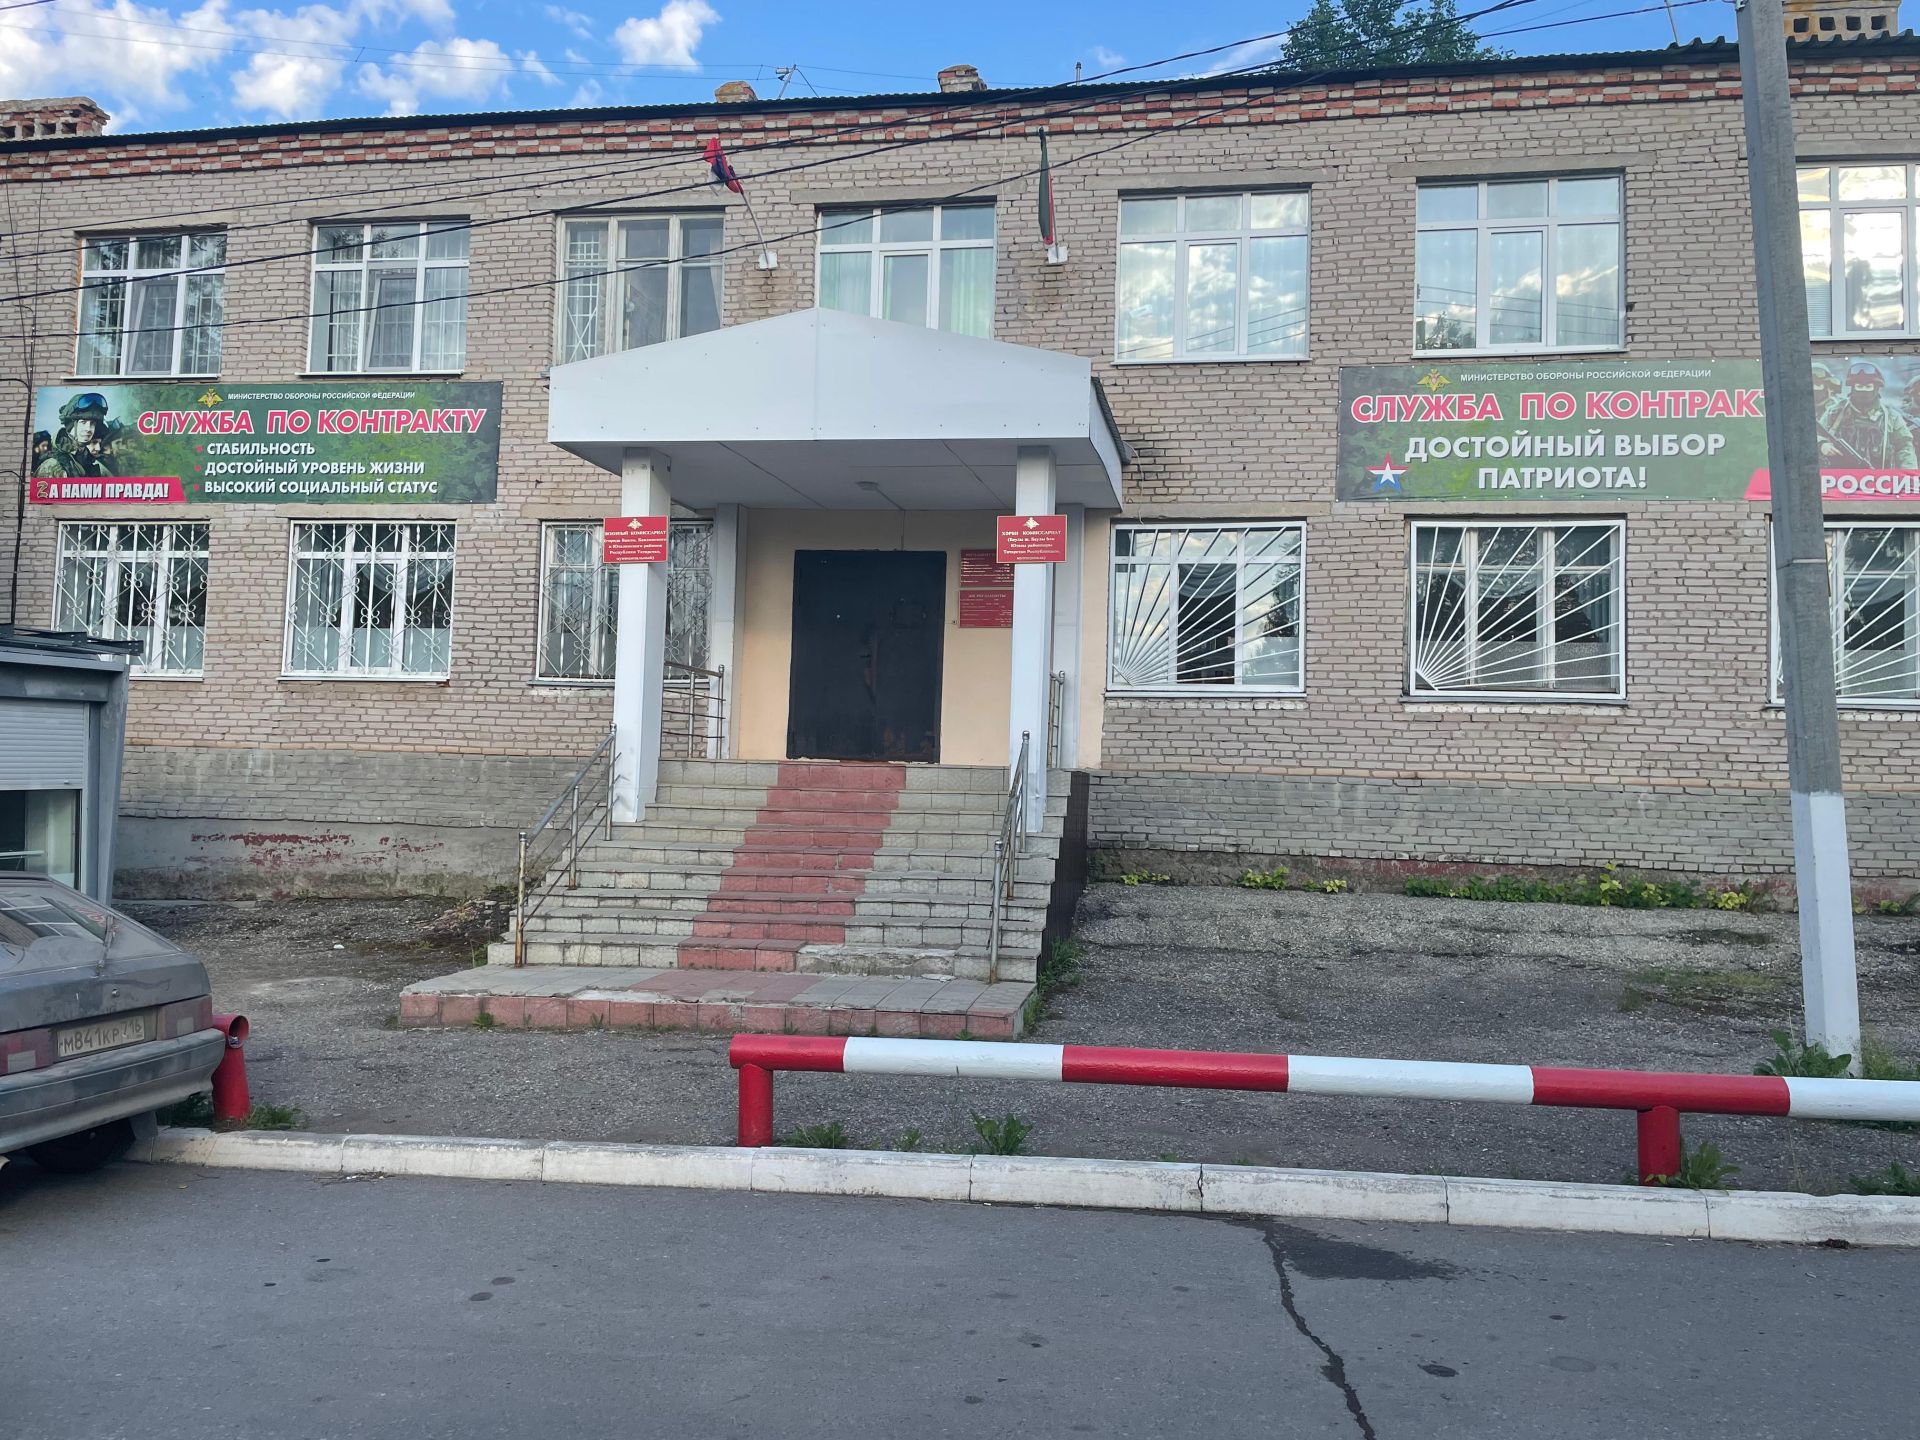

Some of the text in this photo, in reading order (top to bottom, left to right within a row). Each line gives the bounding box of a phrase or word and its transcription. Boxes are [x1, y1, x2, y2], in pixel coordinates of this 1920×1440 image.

[1460, 370, 1712, 382] МИНИСТЕРСТВО ОБОРОНЫ РОССИЙСКОЙ ФЕДЕРАЦИИ
[322, 390, 370, 400] РОССИЙСКОЙ
[372, 392, 416, 400] ФЕДЕРАЦИИ
[1351, 389, 1765, 423] СЛУЖБА ПО КОНТРАК
[138, 409, 487, 434] СЛУЖБА ПО КОНТРАКТУ
[207, 442, 316, 455] СТАБИЛЬНОСТЬ
[1405, 429, 1726, 462] ДОСТОЙНЫЙ ВЫБОР
[204, 459, 424, 476] ДОСТОЙНЫЙ УРОВЕНЬ ЖИЗНИ
[204, 478, 438, 495] ВЫСОКИЙ СОЦИАЛЬНЫЙ СТАТУС
[1479, 466, 1648, 490] ПАТРИОТА!
[62, 484, 102, 498] НАМИ
[106, 482, 169, 500] ПРАВДА!
